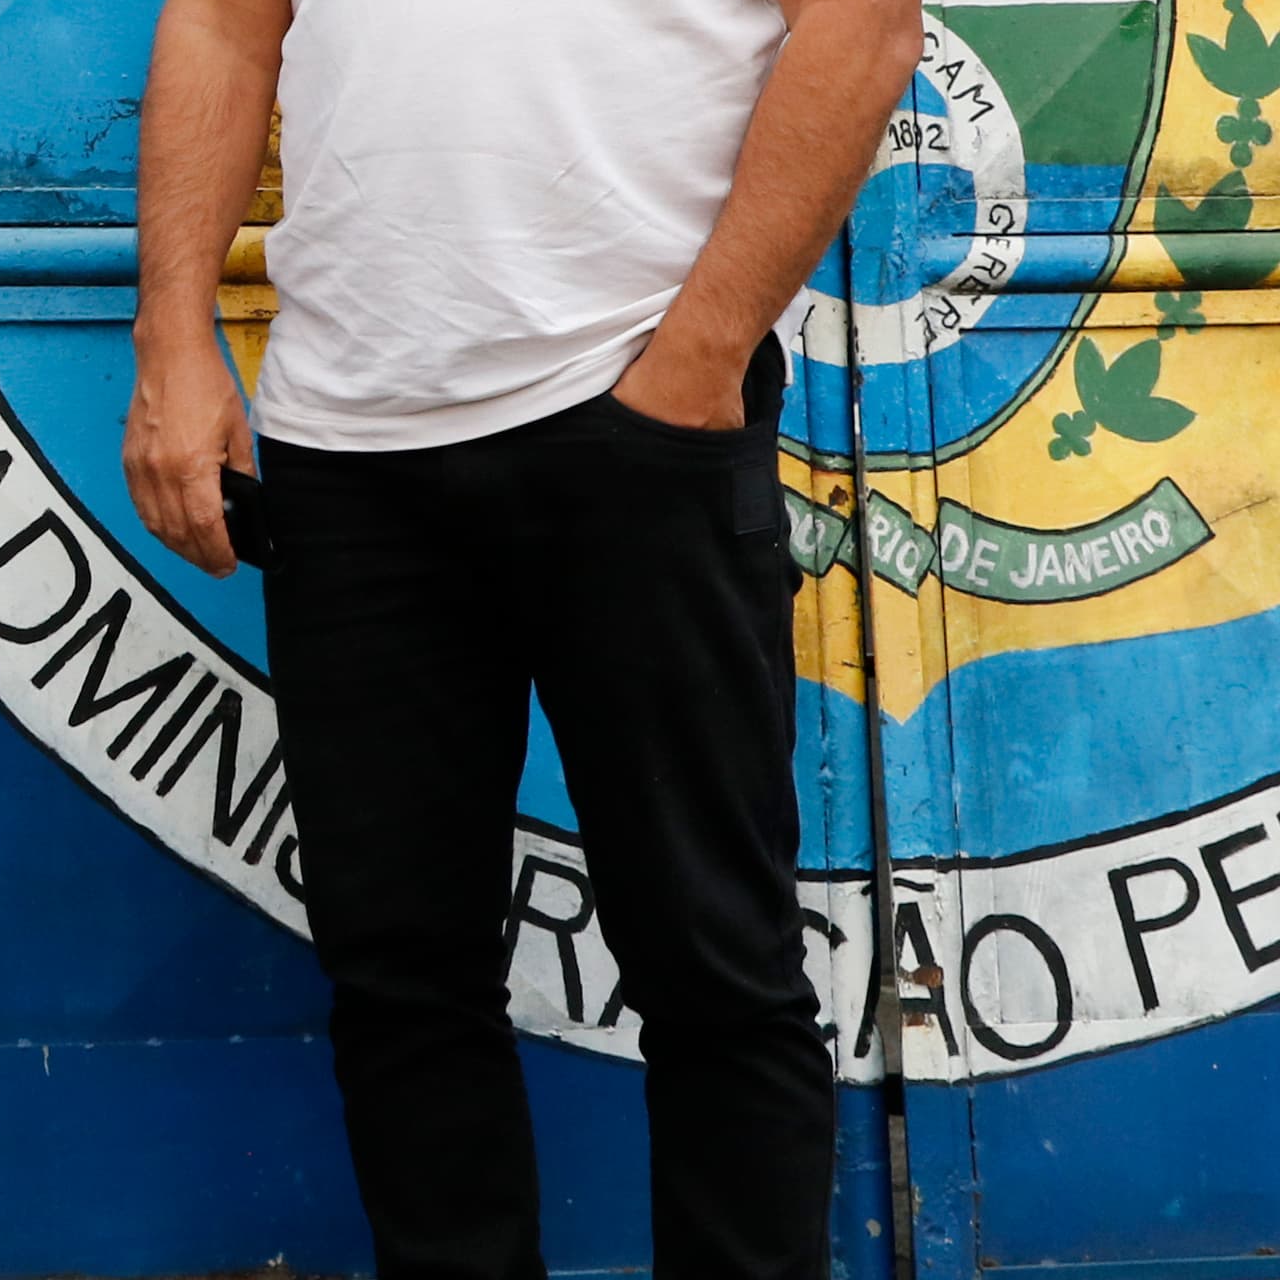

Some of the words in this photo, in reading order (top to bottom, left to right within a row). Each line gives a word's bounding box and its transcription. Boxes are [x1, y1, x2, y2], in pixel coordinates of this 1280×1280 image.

[865, 513, 923, 578] RIO
[940, 522, 1001, 588] DE
[1008, 507, 1173, 589] JANEIRO
